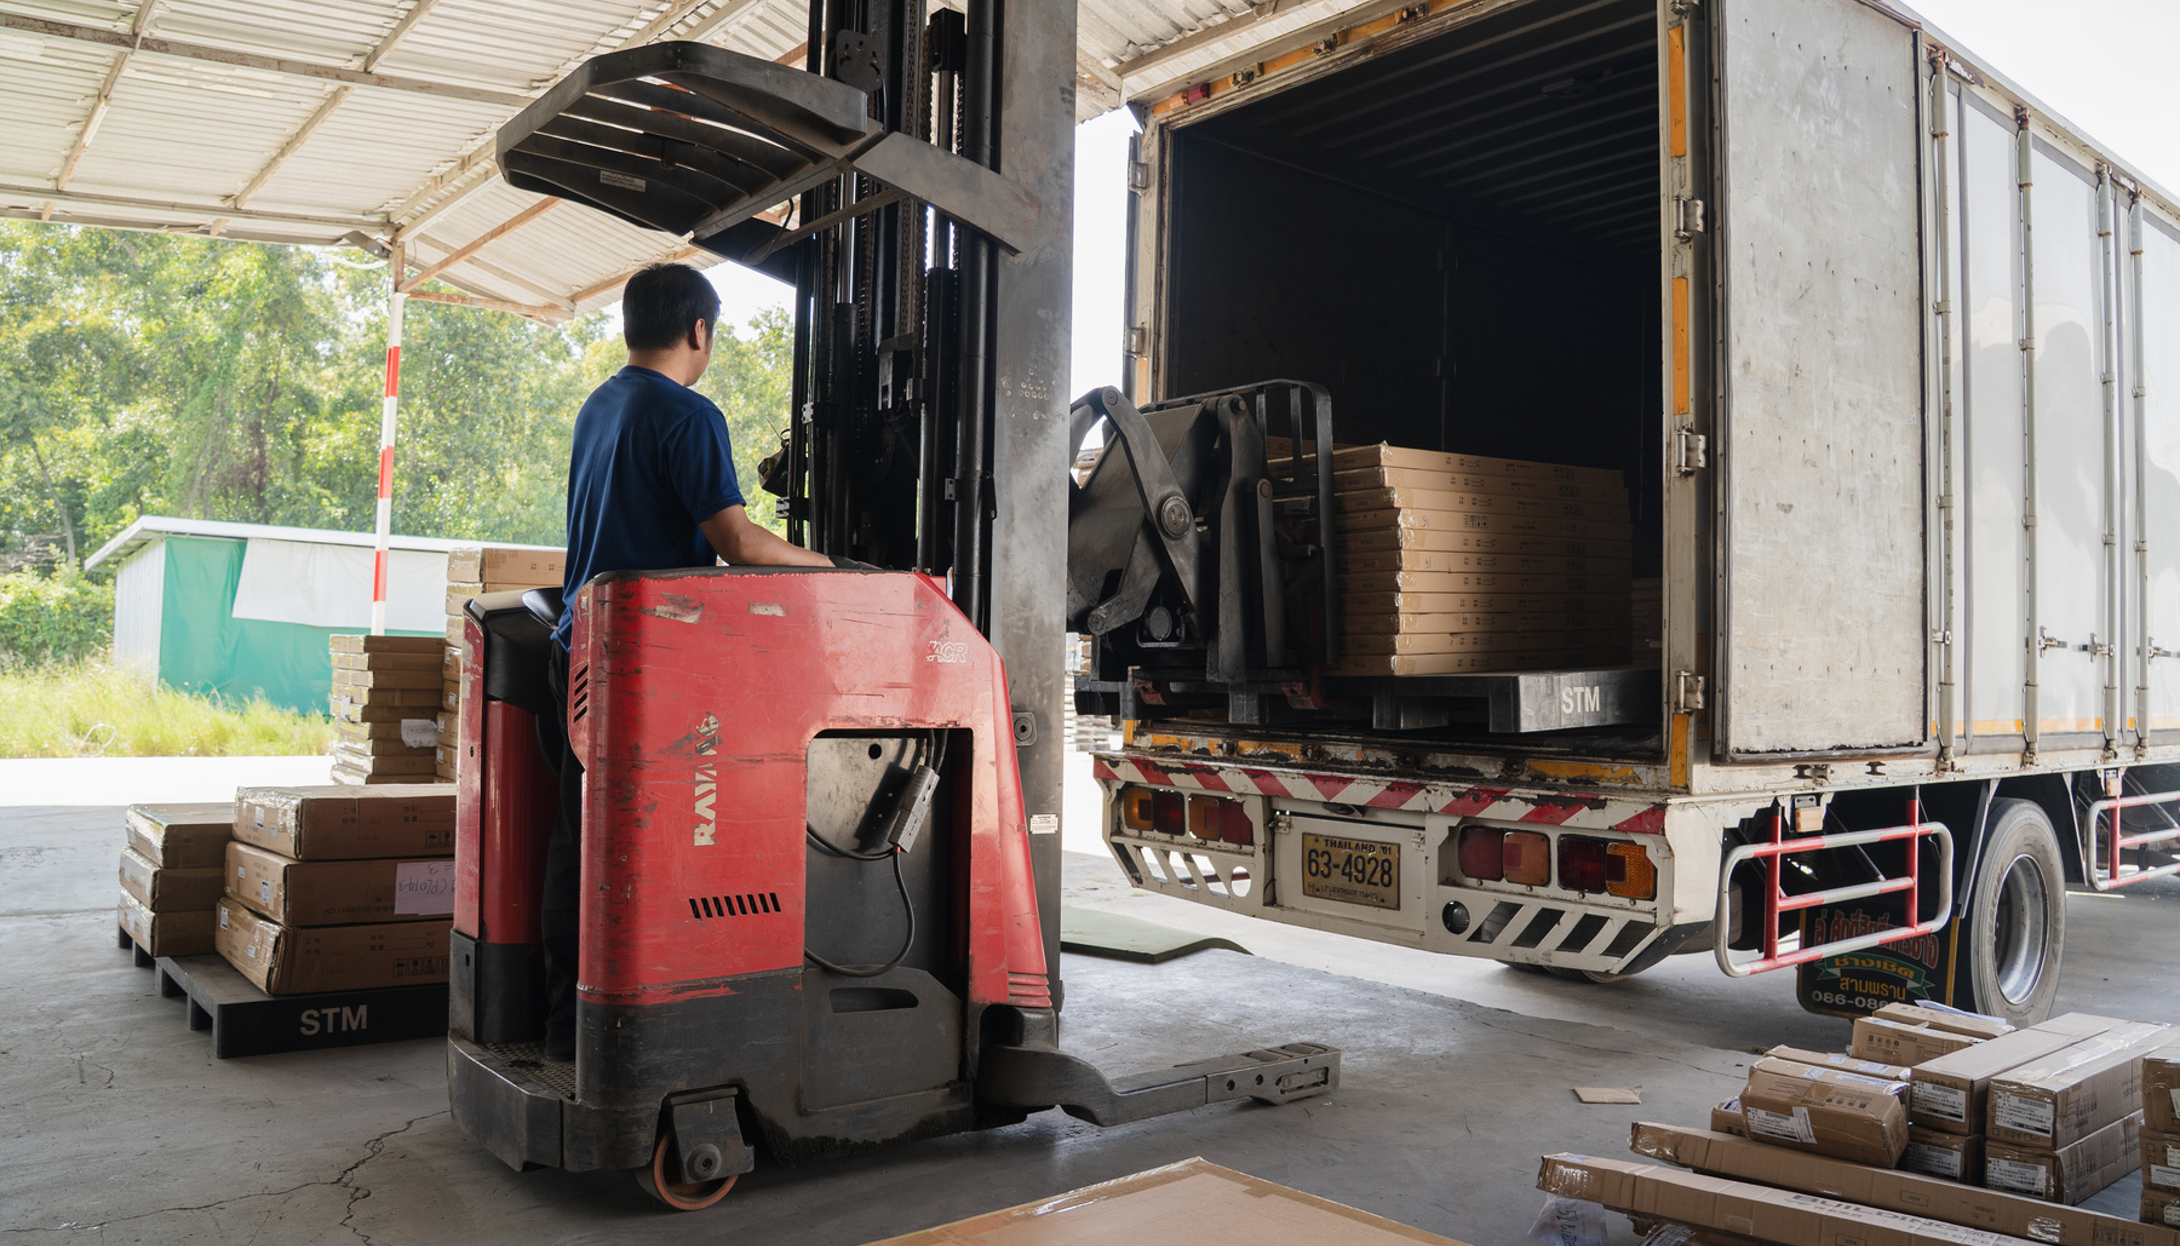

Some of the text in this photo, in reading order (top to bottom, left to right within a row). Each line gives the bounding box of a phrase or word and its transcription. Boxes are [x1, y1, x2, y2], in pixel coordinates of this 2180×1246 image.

[1562, 686, 1600, 714] STM
[1324, 838, 1376, 853] THAILAND
[1307, 848, 1393, 888] 63-4928
[1839, 977, 1906, 1001] สามพราน
[300, 1004, 367, 1036] STM
